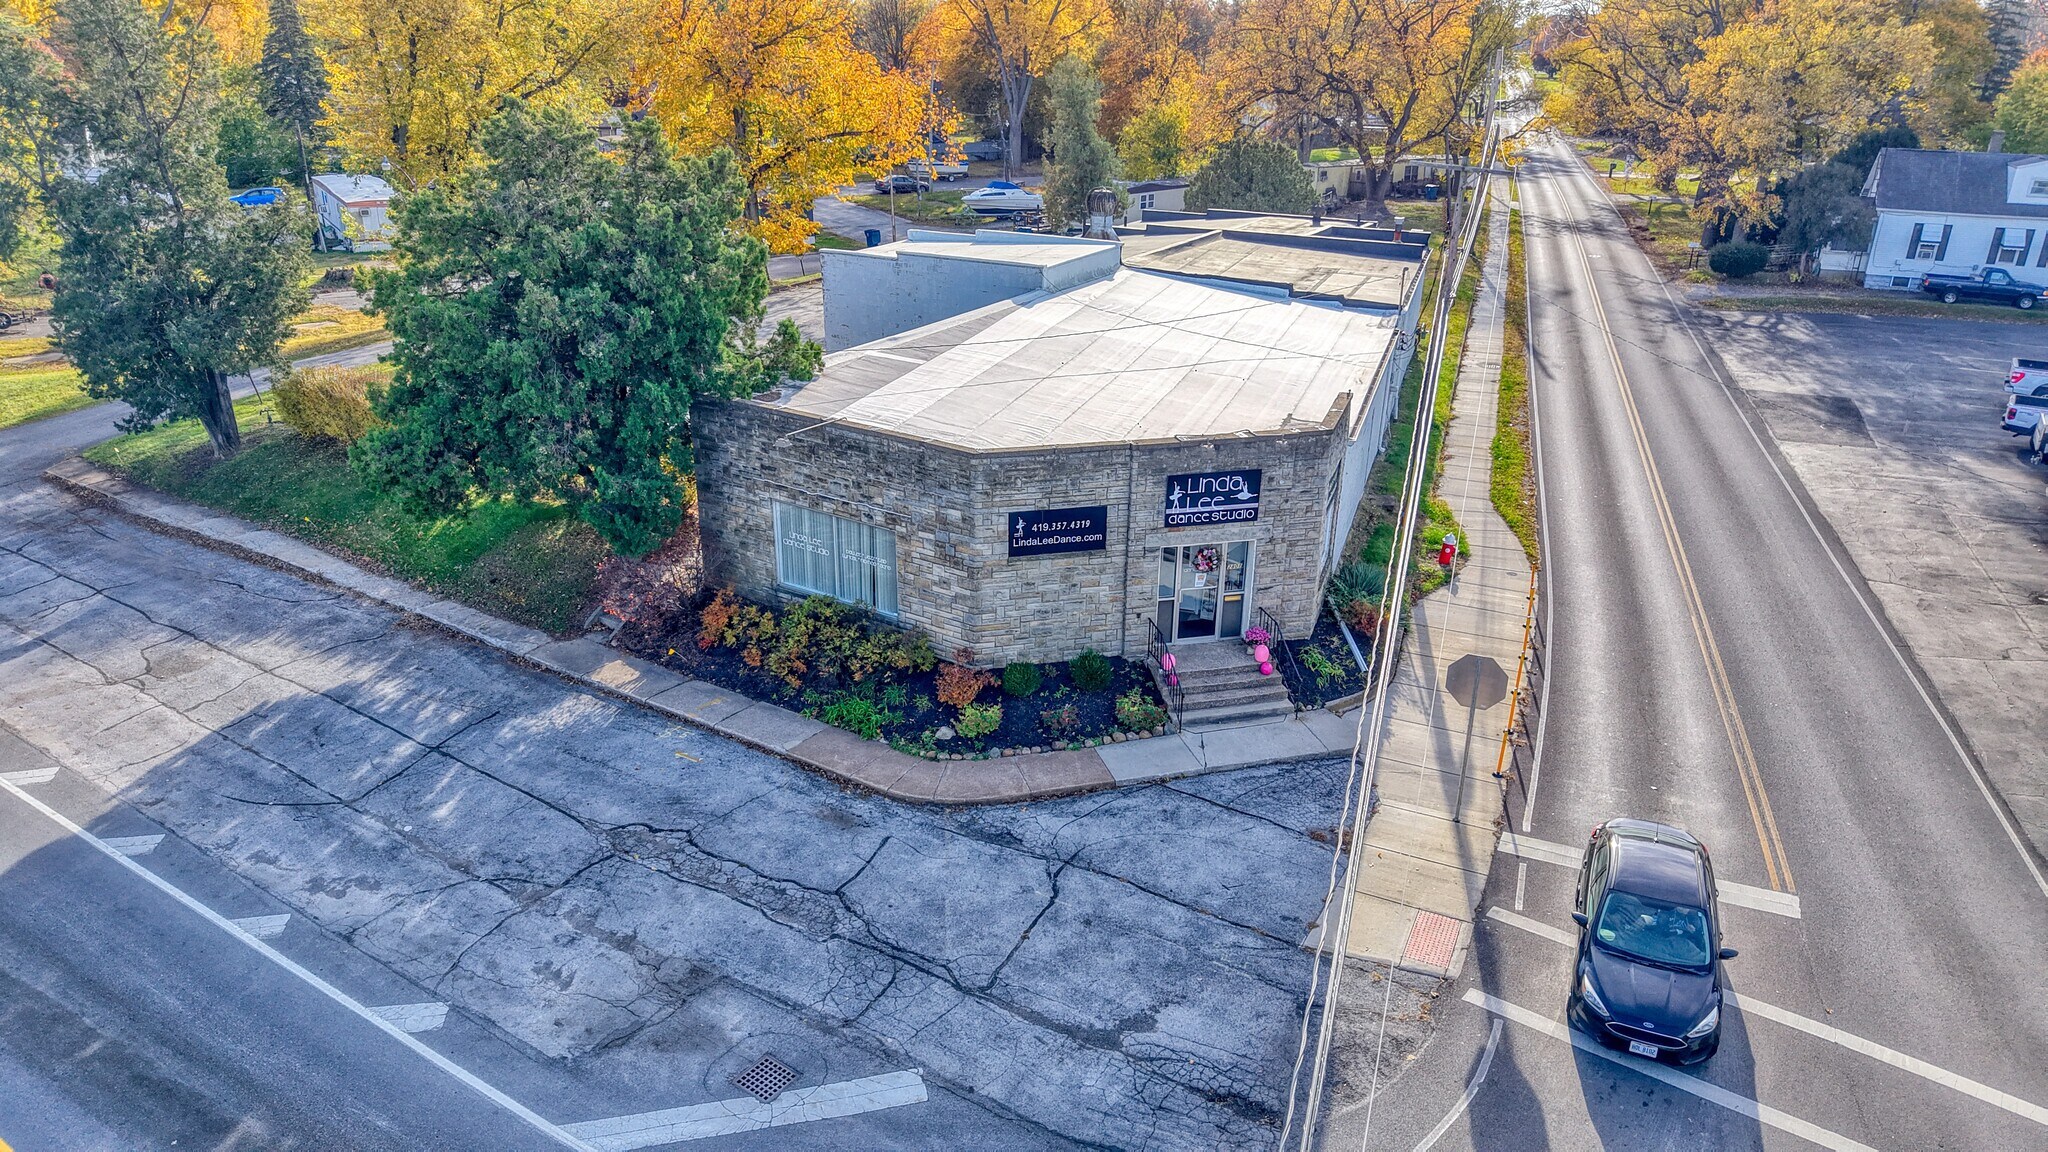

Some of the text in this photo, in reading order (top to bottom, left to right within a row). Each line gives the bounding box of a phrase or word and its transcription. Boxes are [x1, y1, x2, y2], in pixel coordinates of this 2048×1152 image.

[1187, 475, 1243, 494] Linda
[1186, 496, 1225, 512] Lee
[1168, 509, 1255, 524] dance studio
[1031, 519, 1091, 532] 419.357.4319
[1013, 533, 1103, 547] LindaLeeDance.com
